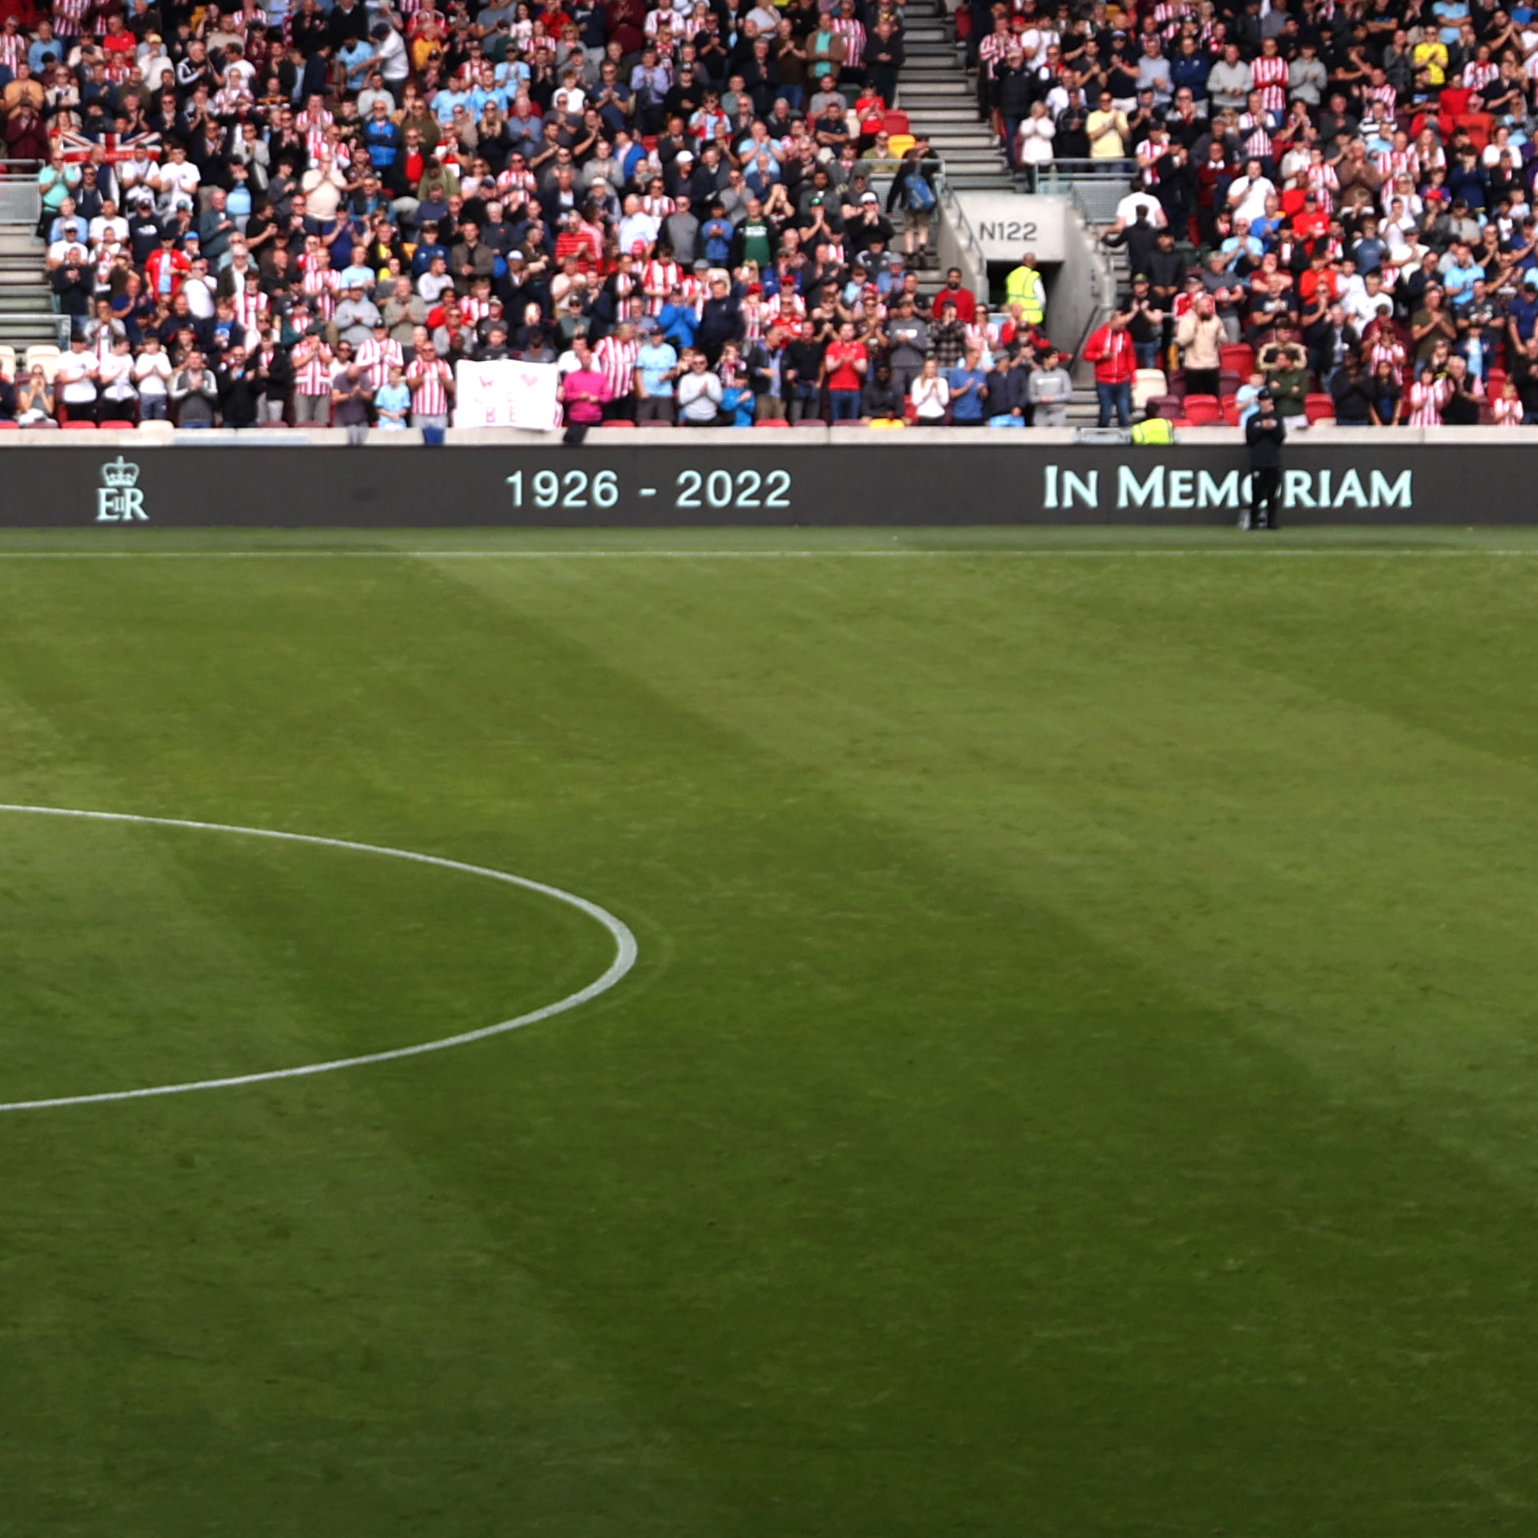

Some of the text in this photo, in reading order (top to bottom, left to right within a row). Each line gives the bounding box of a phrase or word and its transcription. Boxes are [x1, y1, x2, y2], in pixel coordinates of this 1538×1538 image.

[979, 221, 1038, 241] N122
[505, 470, 619, 508] 1926
[676, 470, 792, 508] 2022
